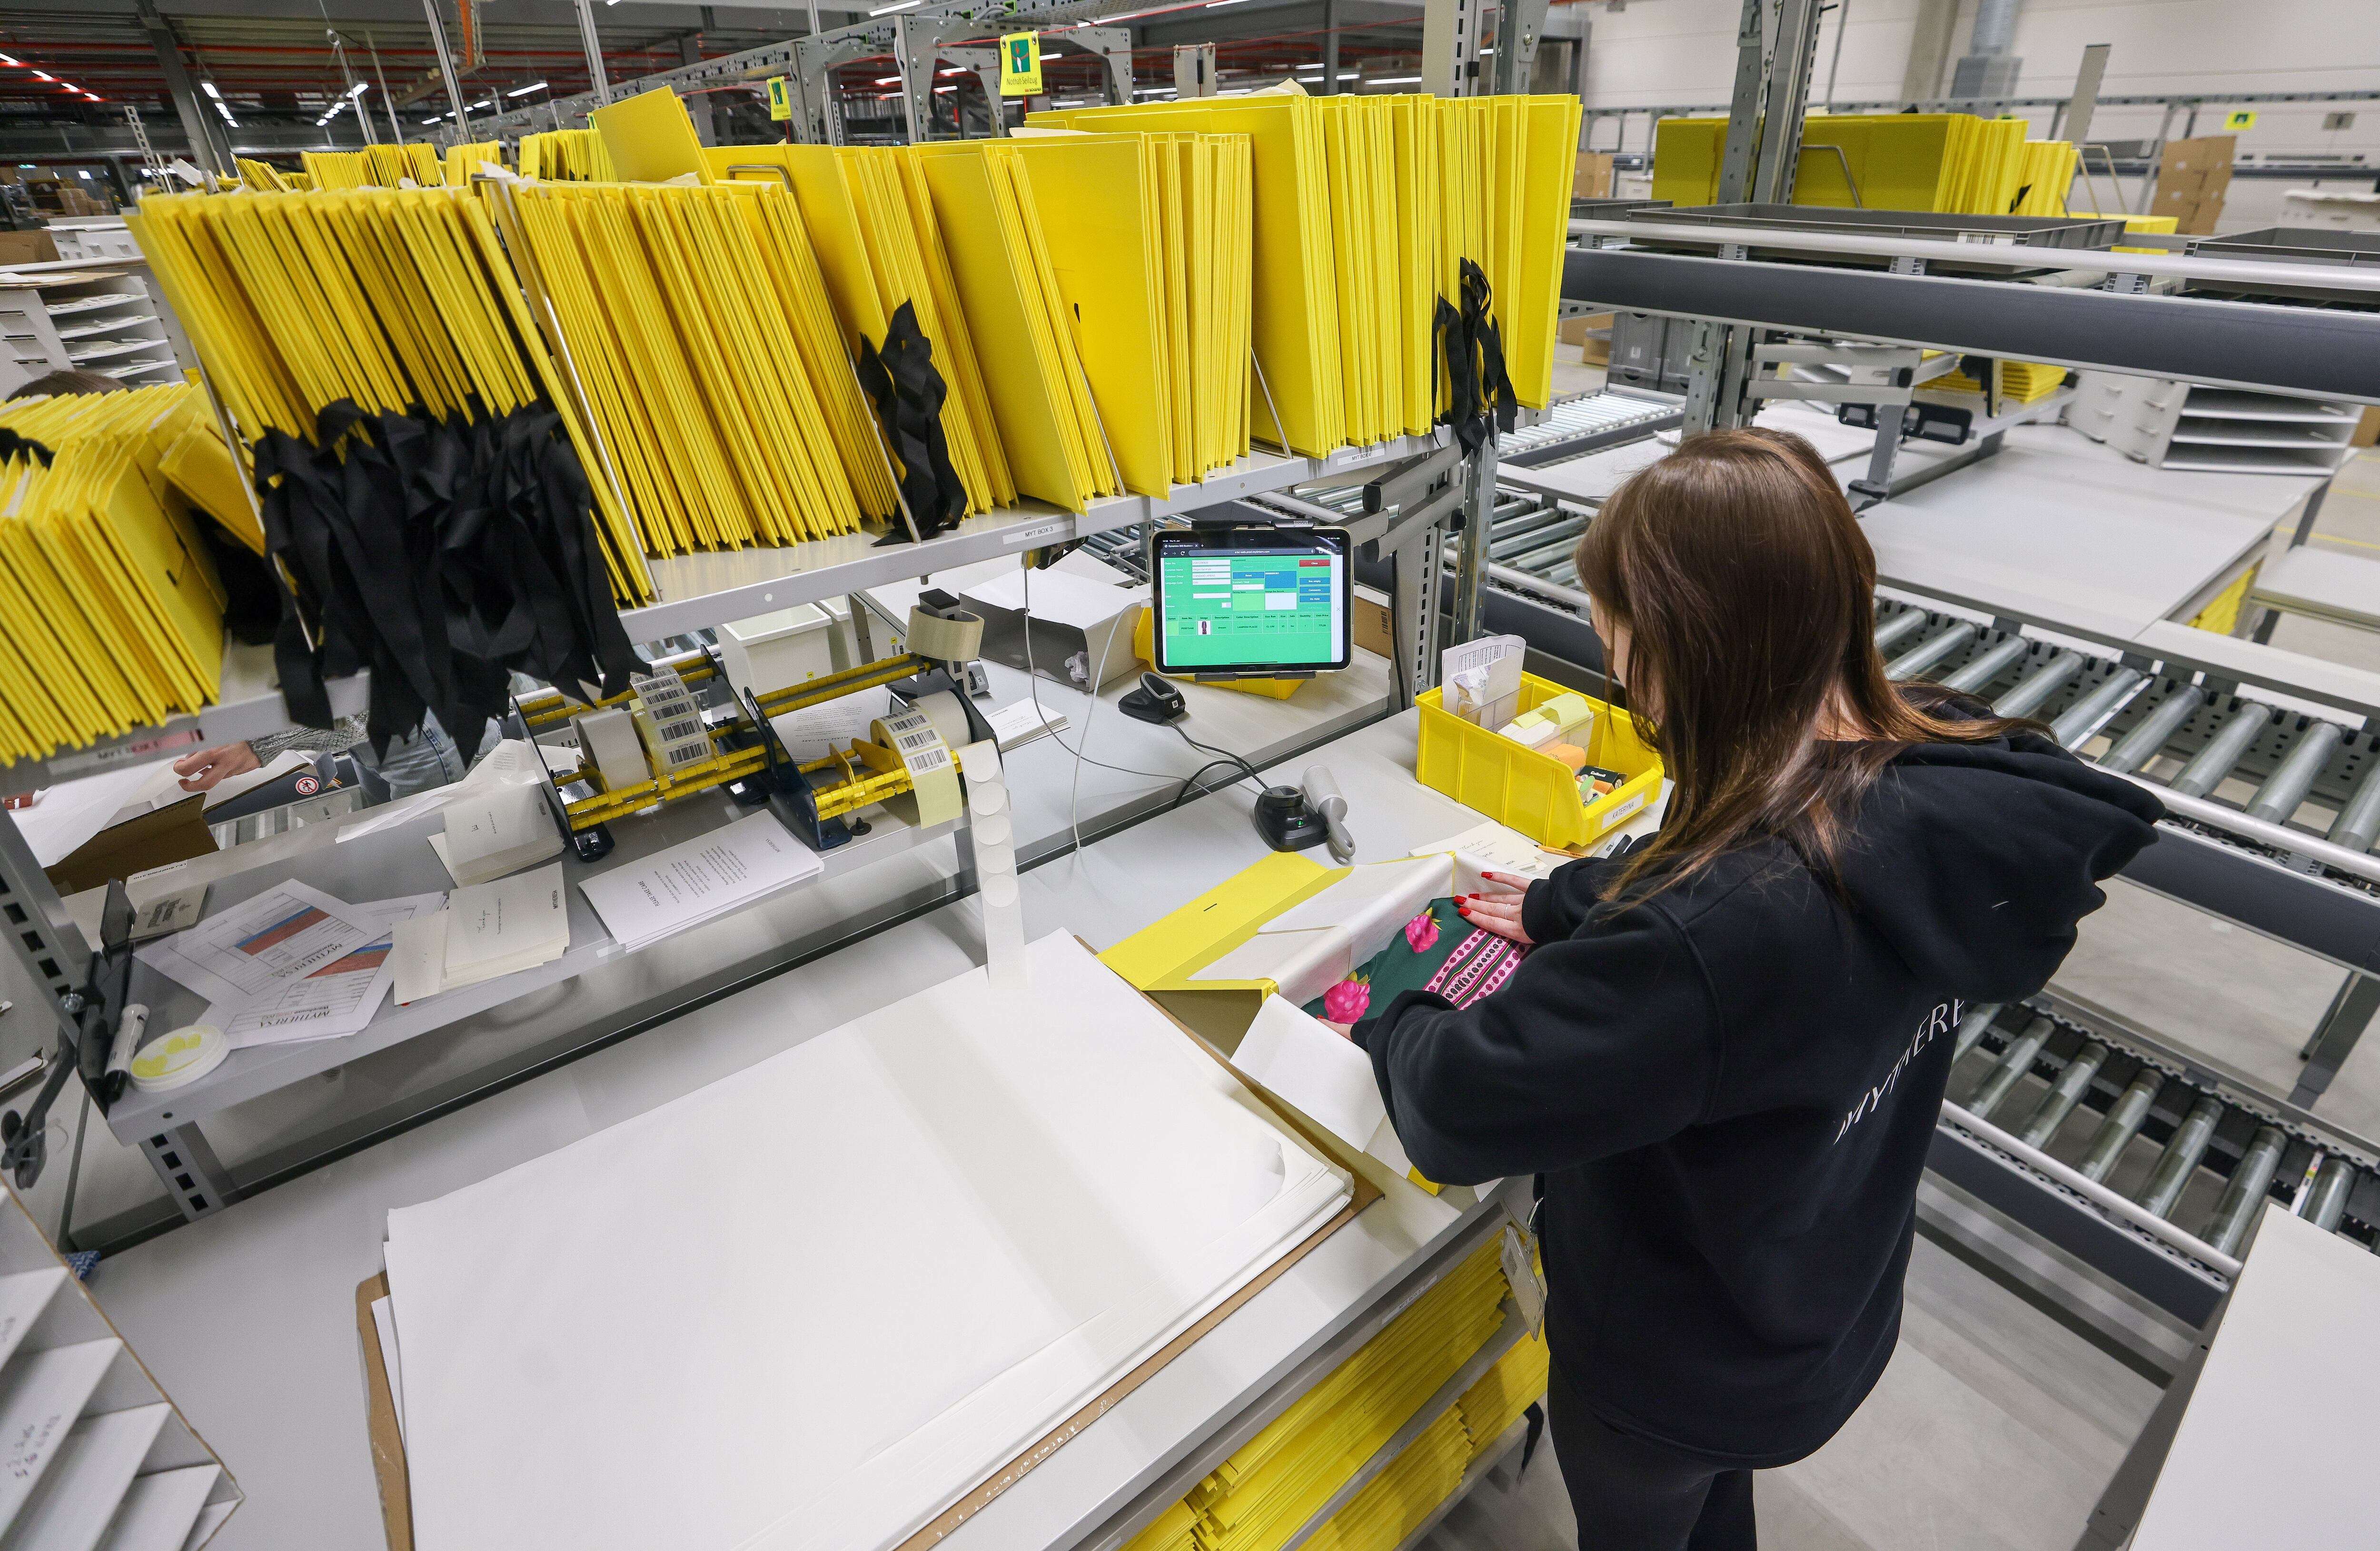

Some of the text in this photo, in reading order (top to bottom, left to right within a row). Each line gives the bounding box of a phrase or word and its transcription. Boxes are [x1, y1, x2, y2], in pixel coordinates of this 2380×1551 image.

[1006, 76, 1038, 85] Nothalt-Seilzug
[1612, 801, 1634, 820] KATERYNA
[638, 880, 647, 889] CARE
[649, 896, 660, 906] PLEASE
[279, 944, 342, 977] MYTHERESA
[260, 1006, 329, 1027] MYTHERESA
